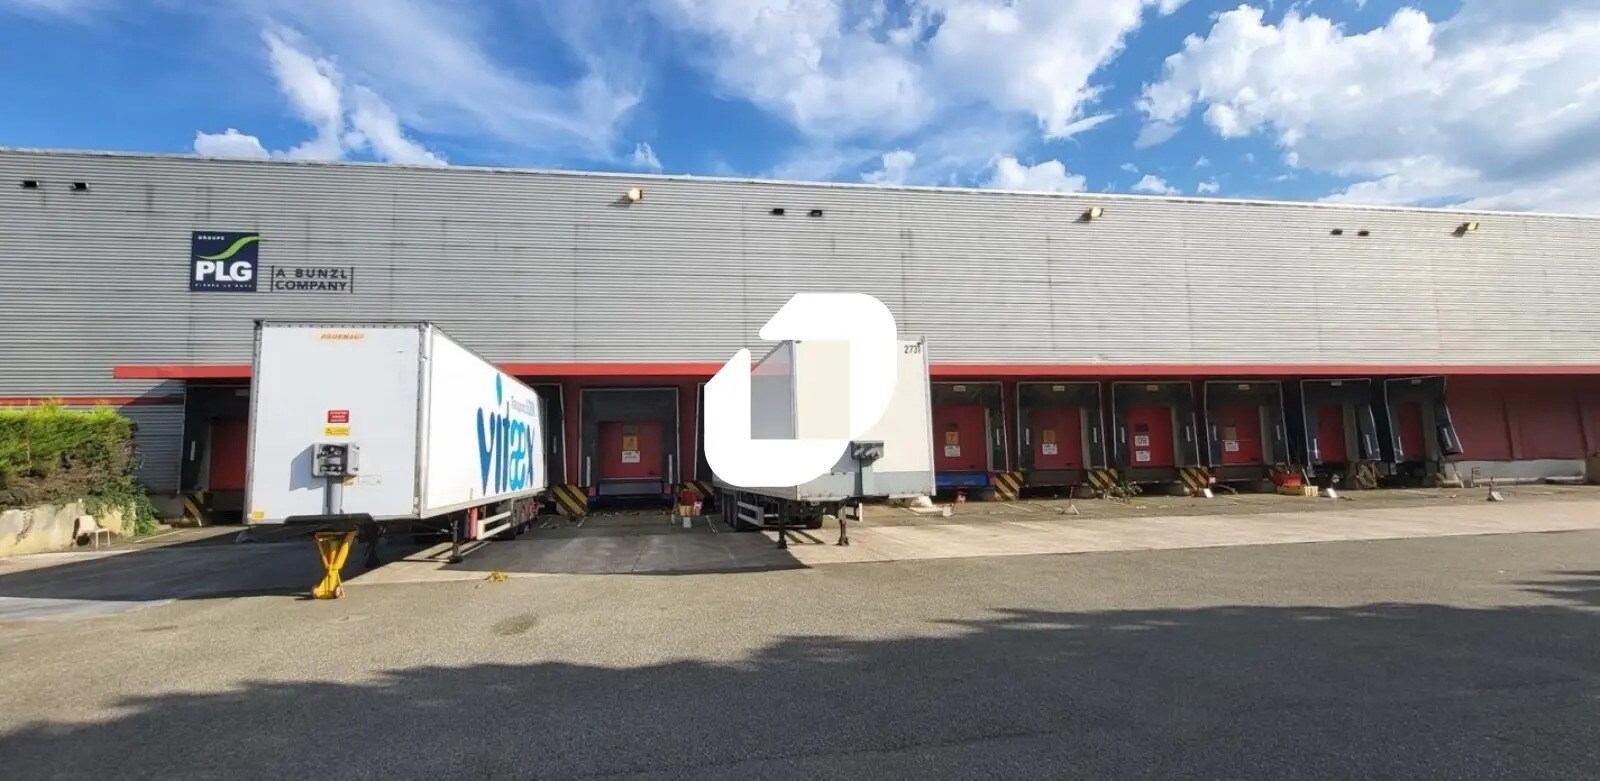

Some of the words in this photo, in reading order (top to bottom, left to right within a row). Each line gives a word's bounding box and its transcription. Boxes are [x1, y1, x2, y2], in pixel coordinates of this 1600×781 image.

[195, 260, 253, 282] PLG
[276, 268, 286, 278] A
[295, 268, 348, 279] BUNZL
[275, 280, 347, 291] COMPANY
